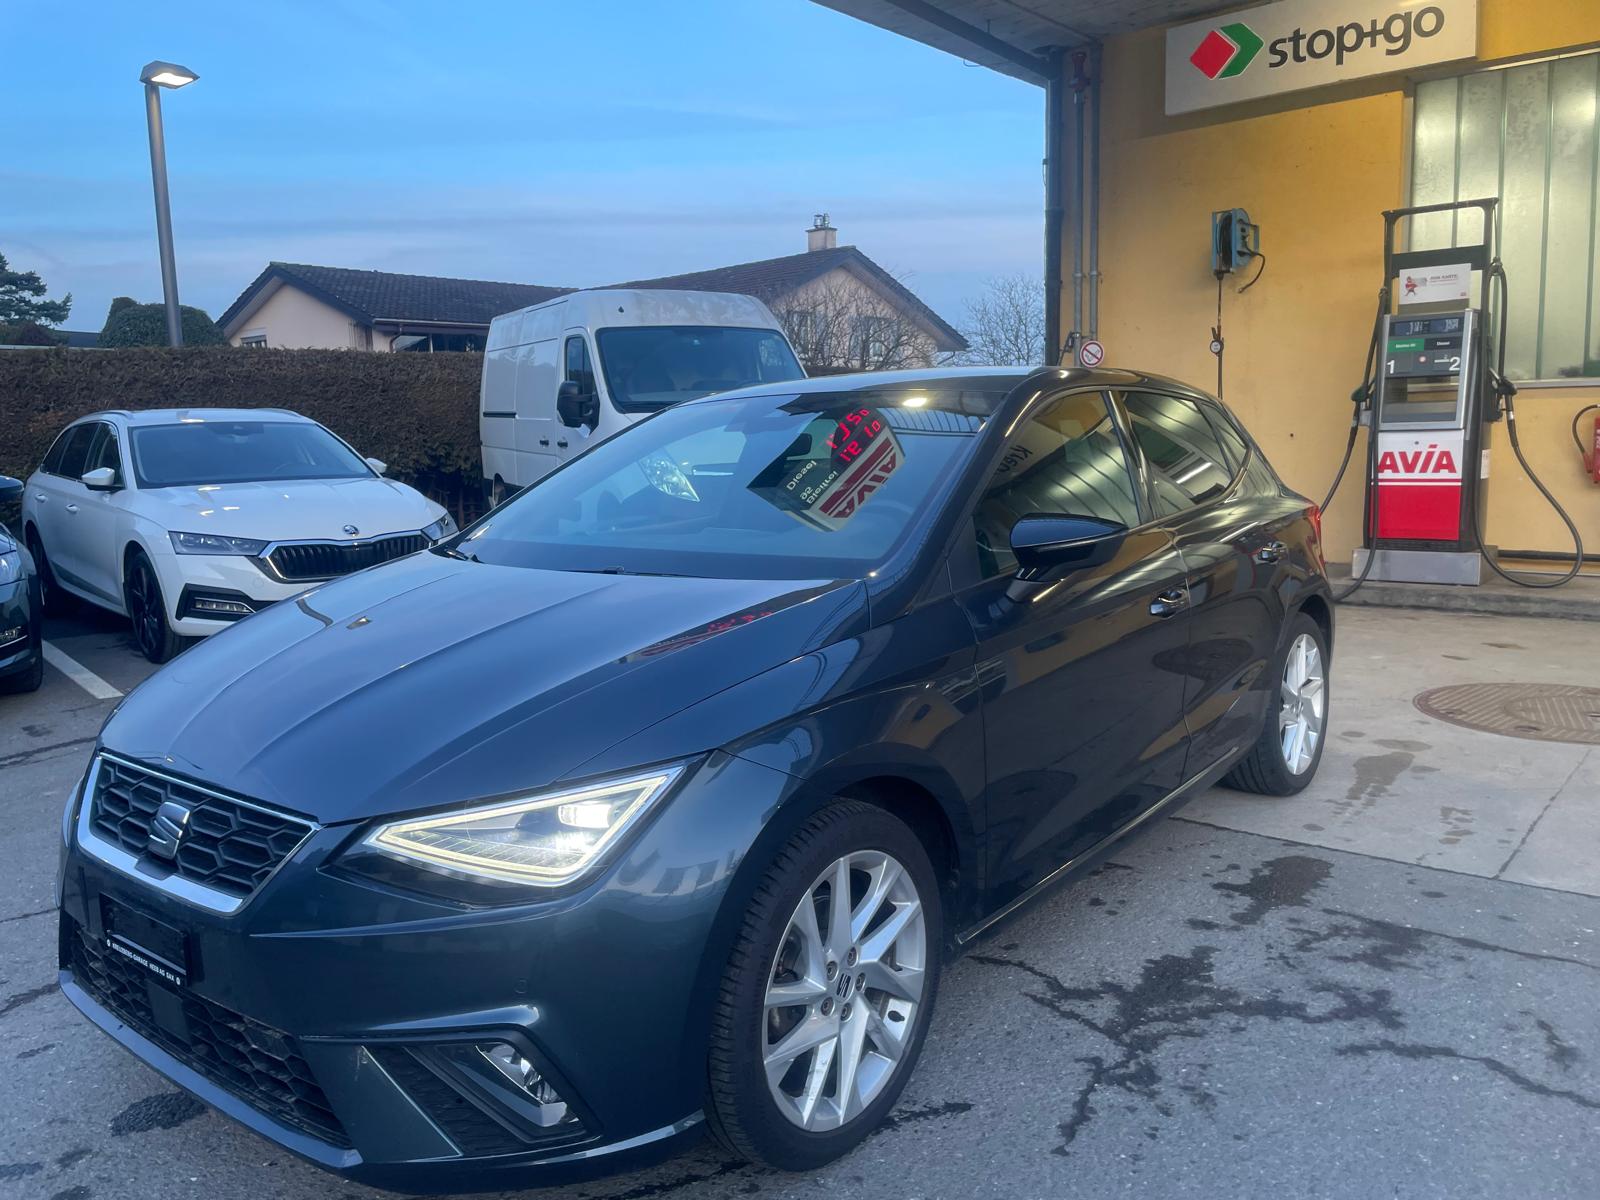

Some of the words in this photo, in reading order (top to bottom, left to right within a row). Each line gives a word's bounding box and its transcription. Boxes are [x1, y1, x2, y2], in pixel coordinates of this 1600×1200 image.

[1269, 6, 1445, 67] stop+go
[1387, 359, 1395, 374] 1
[1448, 356, 1461, 371] 2
[1377, 444, 1457, 474] AVIA
